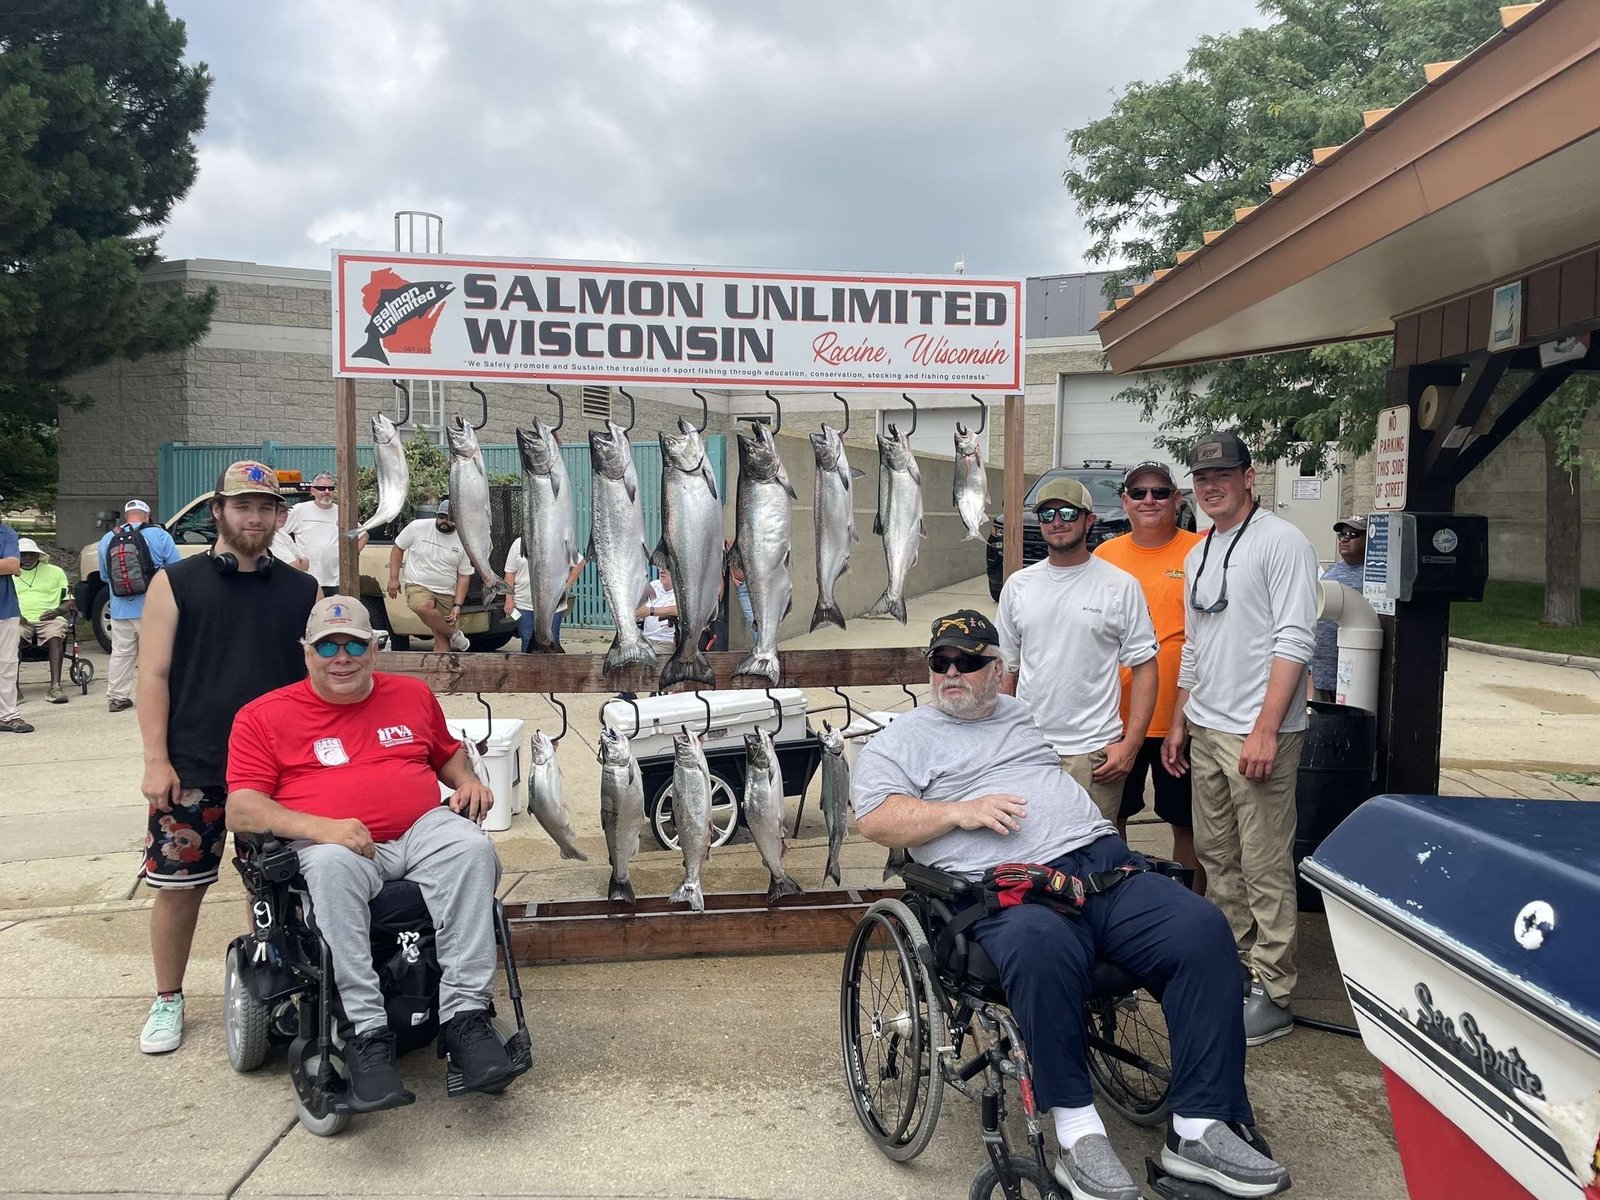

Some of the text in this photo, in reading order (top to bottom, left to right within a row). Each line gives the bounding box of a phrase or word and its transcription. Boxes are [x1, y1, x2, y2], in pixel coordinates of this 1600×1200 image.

[372, 286, 420, 327] salmon
[378, 286, 437, 334] unlimited
[464, 273, 1008, 327] SALMON UNLIMITED
[464, 317, 774, 363] WISCONSIN
[811, 331, 1010, 366] Racine, Wisconsin
[484, 361, 511, 369] Safely
[514, 362, 550, 370] promote
[552, 362, 568, 370] and
[571, 363, 604, 371] Sustain
[606, 364, 620, 372] the
[622, 365, 659, 373] tradition
[673, 367, 696, 375] sport
[698, 368, 728, 376] fishing
[730, 368, 762, 377] through
[764, 369, 808, 378] education,
[810, 371, 865, 379] conservation,
[868, 372, 902, 380] stocking
[921, 372, 949, 381] fishing
[1388, 415, 1397, 432] NO
[1380, 436, 1404, 454] PARKING
[1377, 458, 1404, 477] THIS SIDE
[1375, 481, 1404, 498] OF STREET
[1414, 982, 1547, 1102] Sea Sprite
